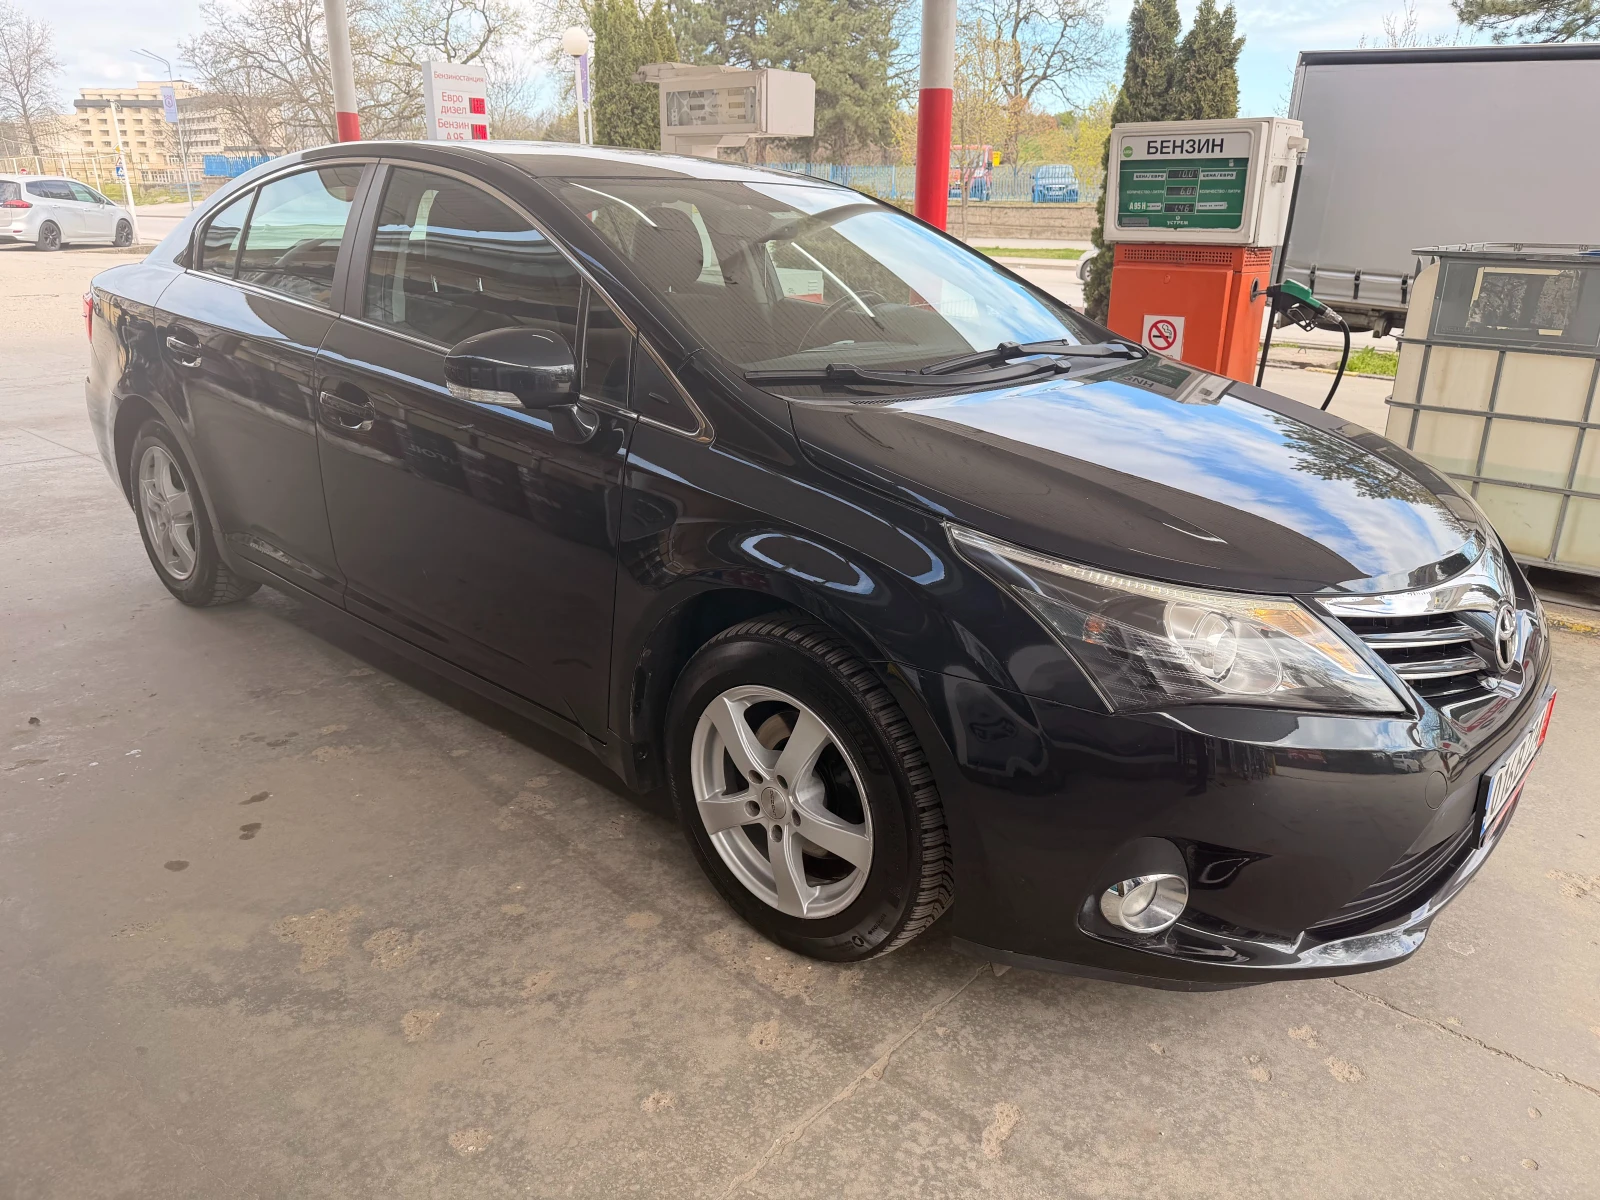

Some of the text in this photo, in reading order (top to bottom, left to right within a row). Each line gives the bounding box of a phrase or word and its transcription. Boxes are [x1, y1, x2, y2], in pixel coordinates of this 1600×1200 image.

[434, 71, 483, 83] Бензиностанция
[442, 92, 463, 104] Евро
[440, 105, 467, 115] дизел
[437, 118, 470, 130] Бензин
[1146, 137, 1225, 155] БЕНЗИН
